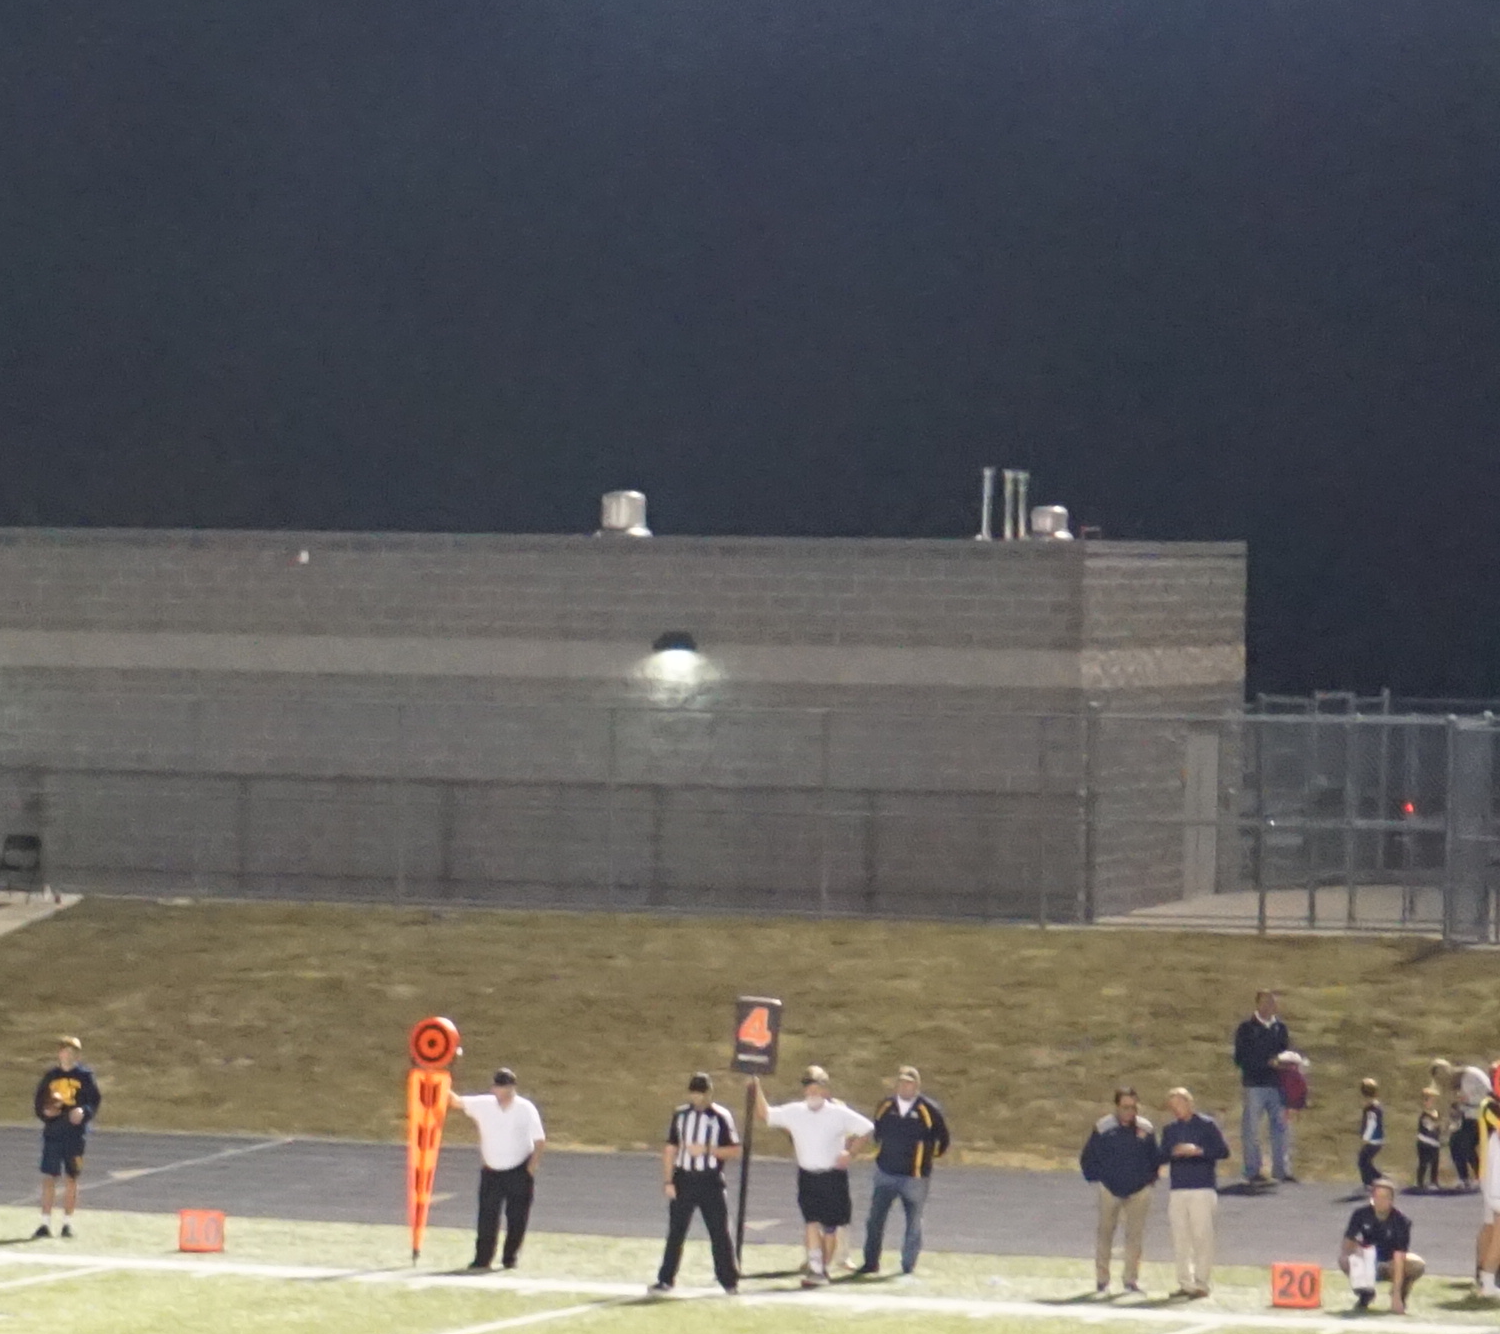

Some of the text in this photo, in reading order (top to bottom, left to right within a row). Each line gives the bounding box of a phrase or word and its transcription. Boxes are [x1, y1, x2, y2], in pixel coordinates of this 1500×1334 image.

[737, 1006, 773, 1049] 4
[184, 1215, 221, 1246] 10
[1277, 1268, 1317, 1300] 20
